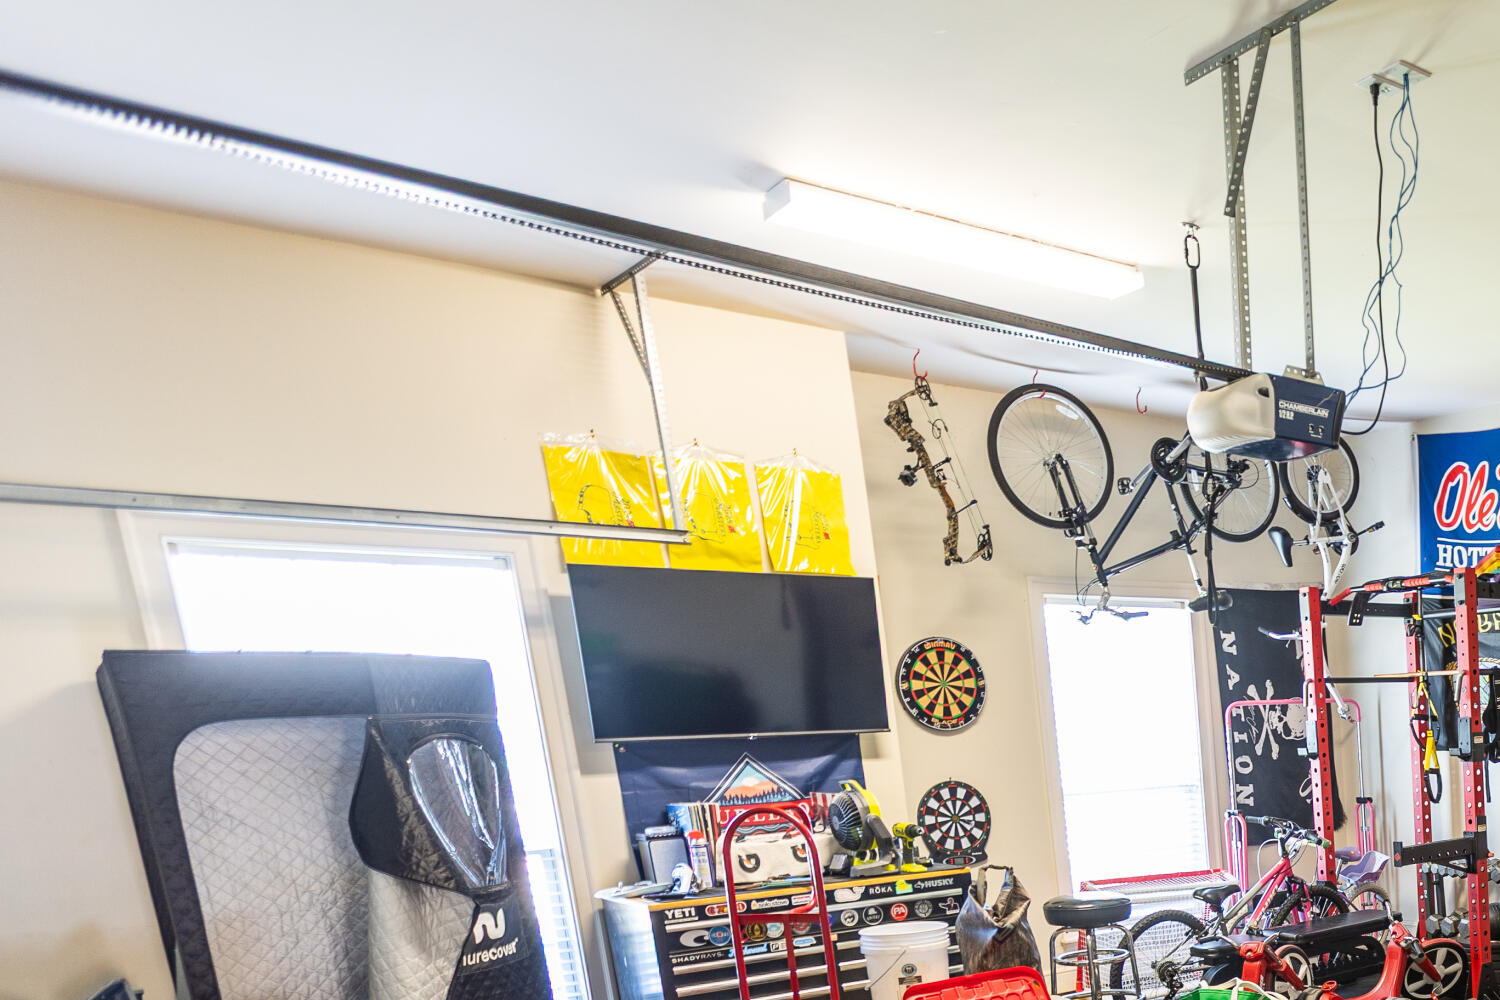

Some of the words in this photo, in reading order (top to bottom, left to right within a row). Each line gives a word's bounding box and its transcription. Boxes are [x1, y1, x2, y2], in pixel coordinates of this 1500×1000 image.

[1279, 399, 1330, 419] CHAMBERLAIN
[1433, 461, 1500, 534] Ole
[1219, 629, 1255, 807] NATION
[924, 877, 955, 888] HUSKY
[664, 906, 697, 920] YETI
[671, 951, 723, 964] SHADYRAYS
